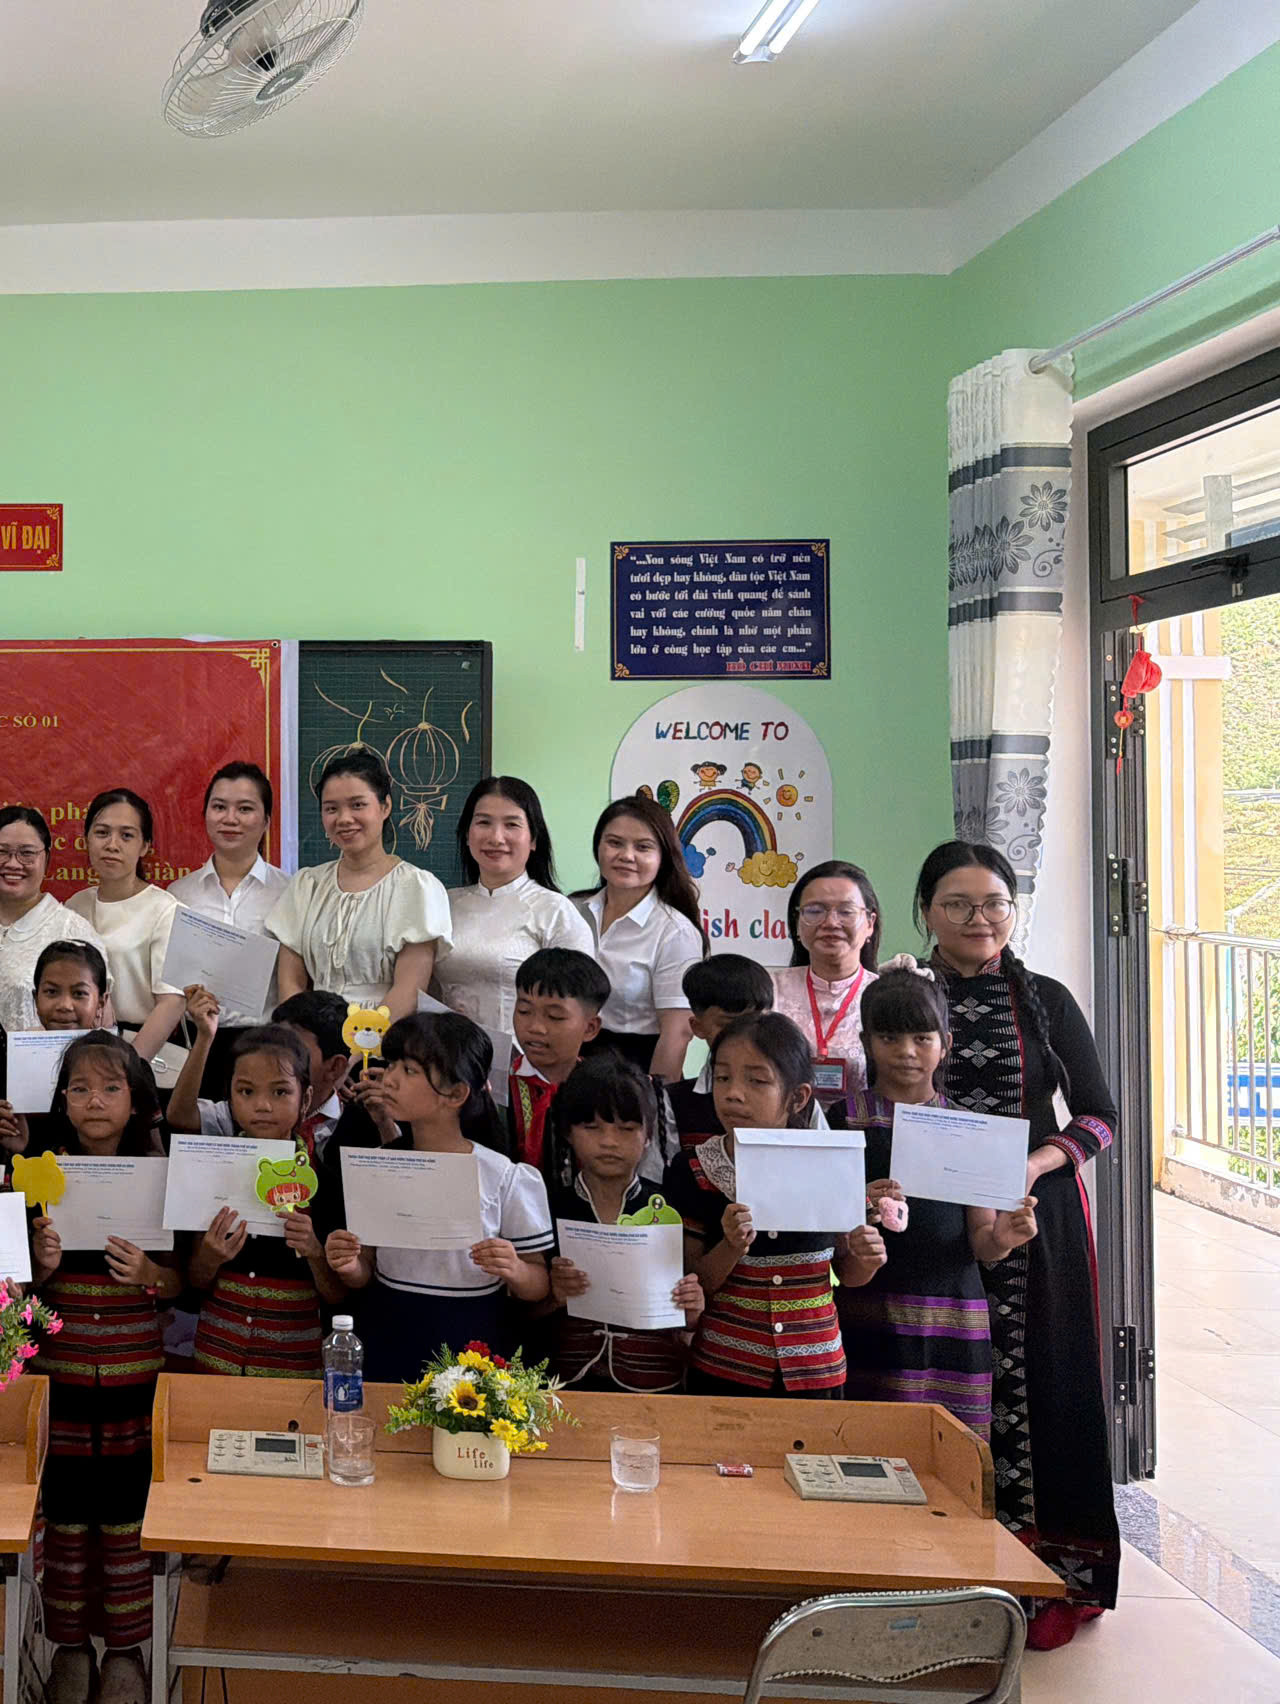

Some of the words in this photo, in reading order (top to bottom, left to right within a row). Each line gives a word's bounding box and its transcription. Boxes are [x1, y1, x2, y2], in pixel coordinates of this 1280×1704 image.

[0, 521, 16, 550] VĨ
[22, 526, 50, 554] ĐẠI
[13, 713, 37, 727] SỐ
[42, 715, 59, 727] 01
[656, 720, 751, 741] WELCOME
[761, 721, 789, 741] TO
[44, 867, 101, 886] ang
[750, 909, 792, 940] cla
[457, 1447, 486, 1459] Life
